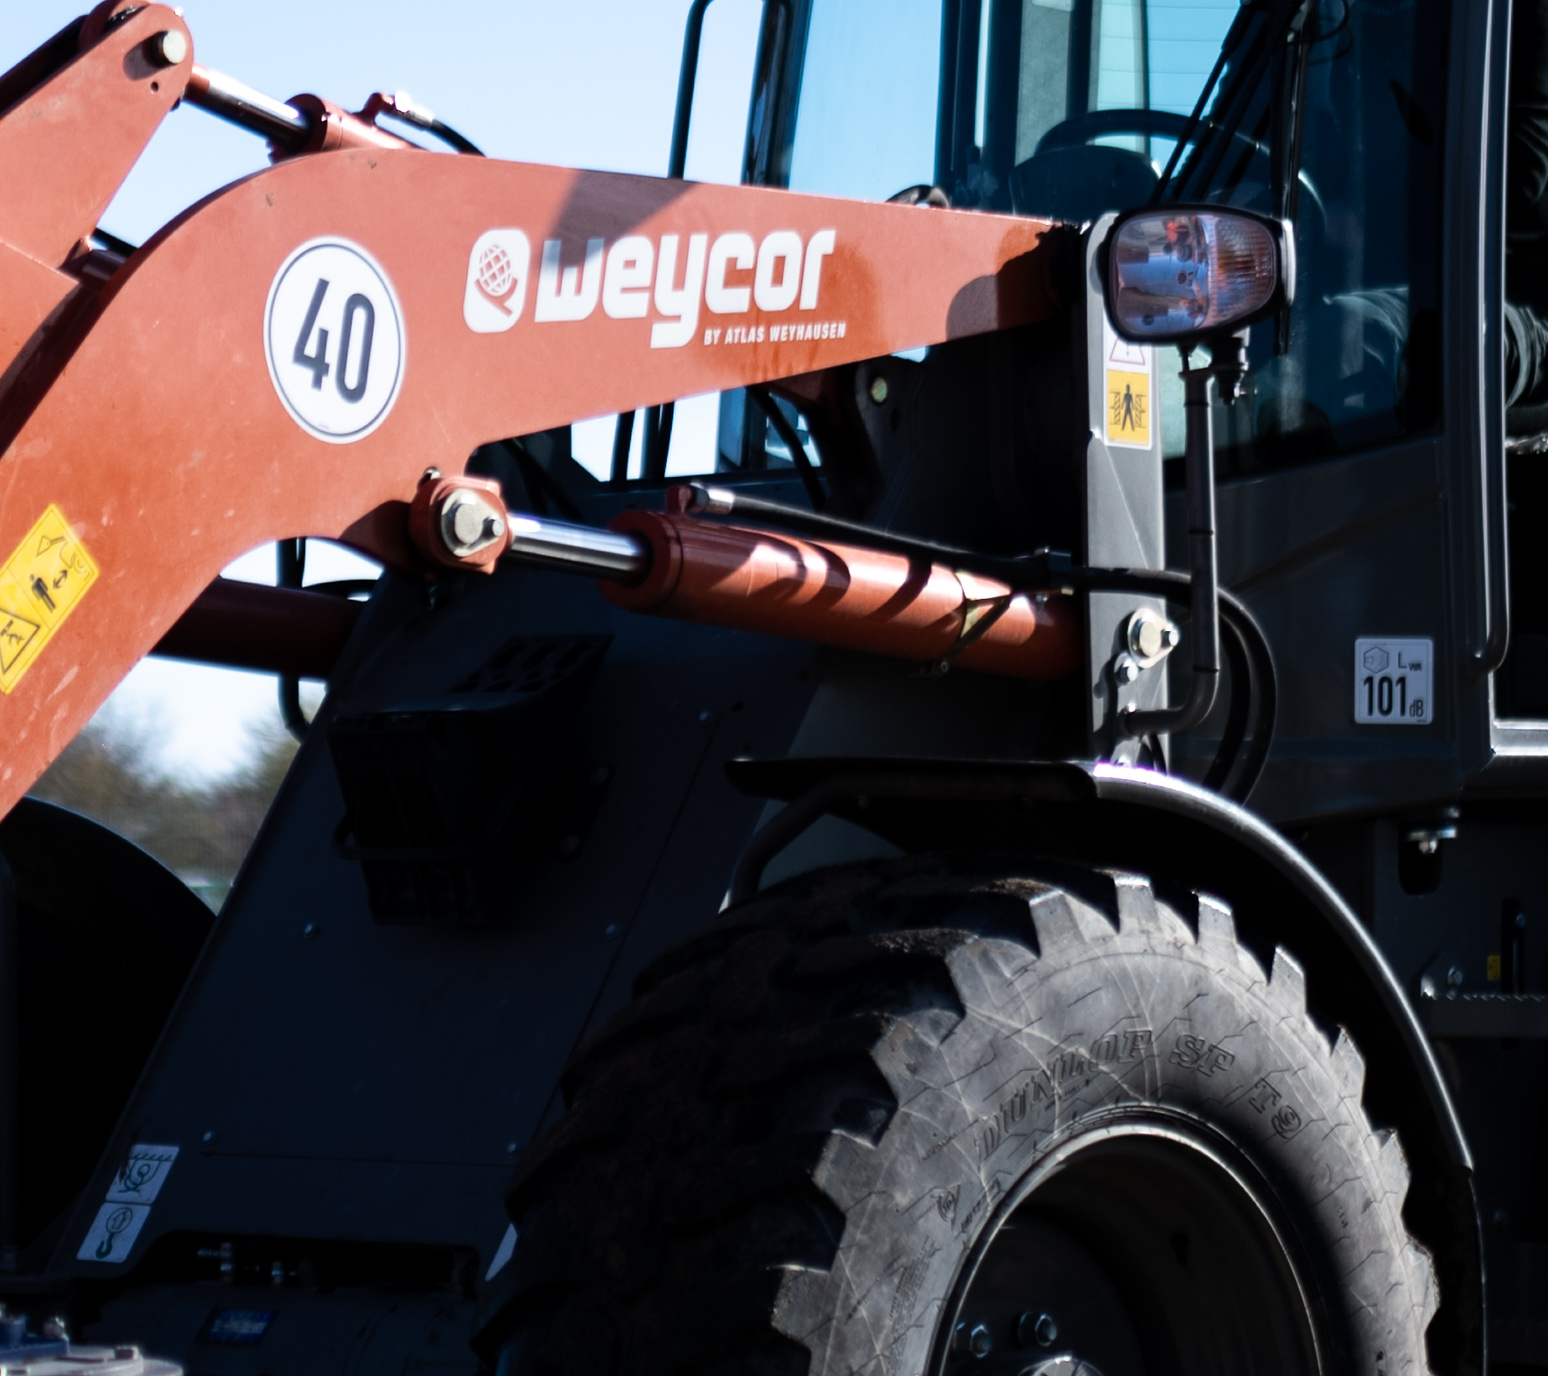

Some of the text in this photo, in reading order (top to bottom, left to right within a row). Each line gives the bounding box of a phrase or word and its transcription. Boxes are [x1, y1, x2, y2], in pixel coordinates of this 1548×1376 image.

[293, 278, 375, 405] 40
[534, 229, 837, 349] weycor
[704, 322, 846, 345] BY ATLAS WEYHAUSEN
[1363, 676, 1424, 717] 101 dB
[978, 1029, 1153, 1161] DUNLOP
[1169, 1034, 1235, 1077] SP
[1248, 1076, 1302, 1140] T9
